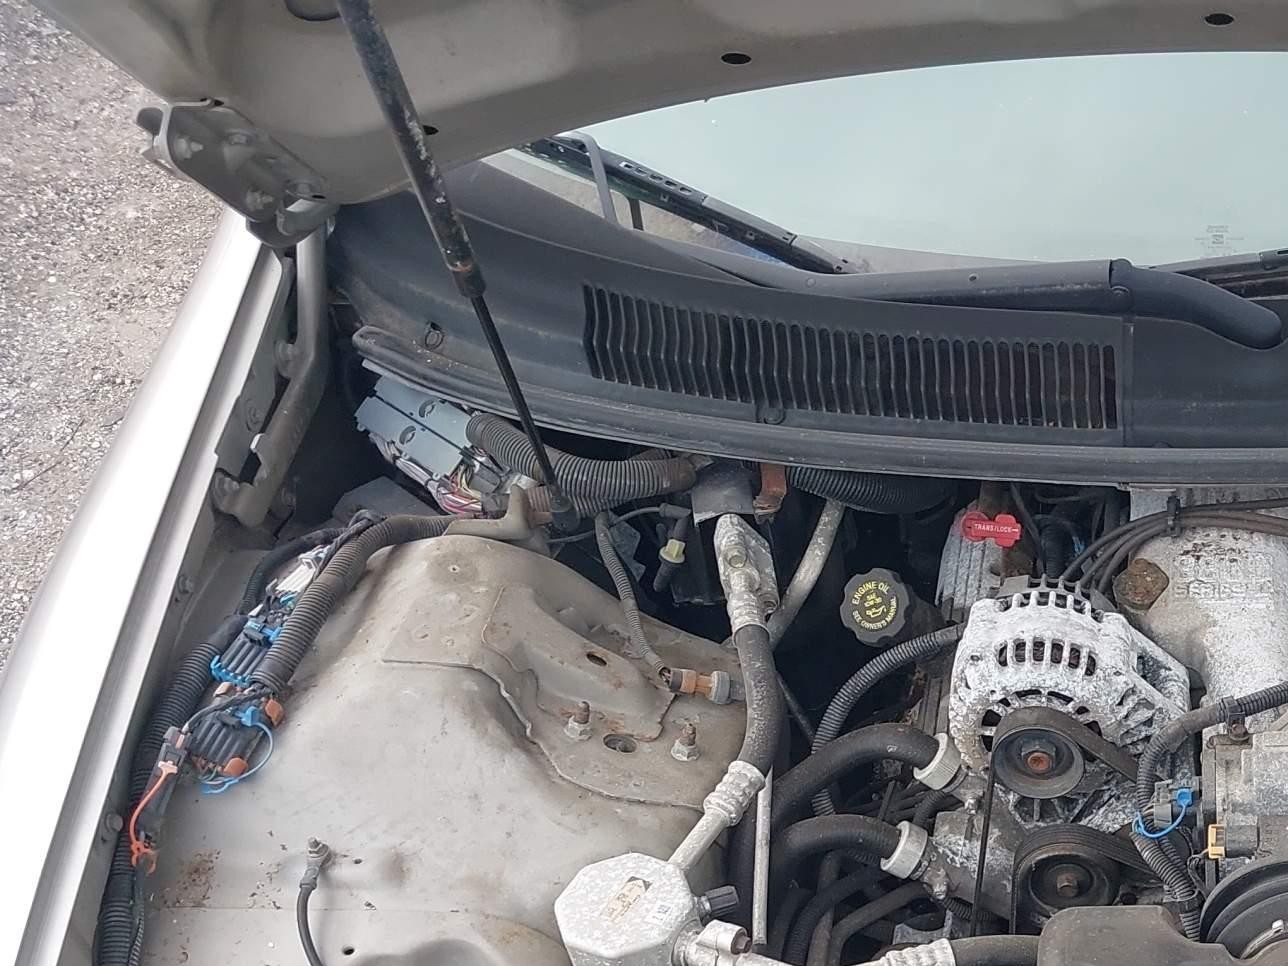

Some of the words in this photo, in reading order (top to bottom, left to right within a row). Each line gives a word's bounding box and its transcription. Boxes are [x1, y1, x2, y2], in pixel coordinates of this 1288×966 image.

[974, 523, 1012, 533] TRANS/LOCK
[852, 581, 877, 605] ENGINE
[878, 582, 890, 594] OIL
[885, 596, 896, 623] MANUAL
